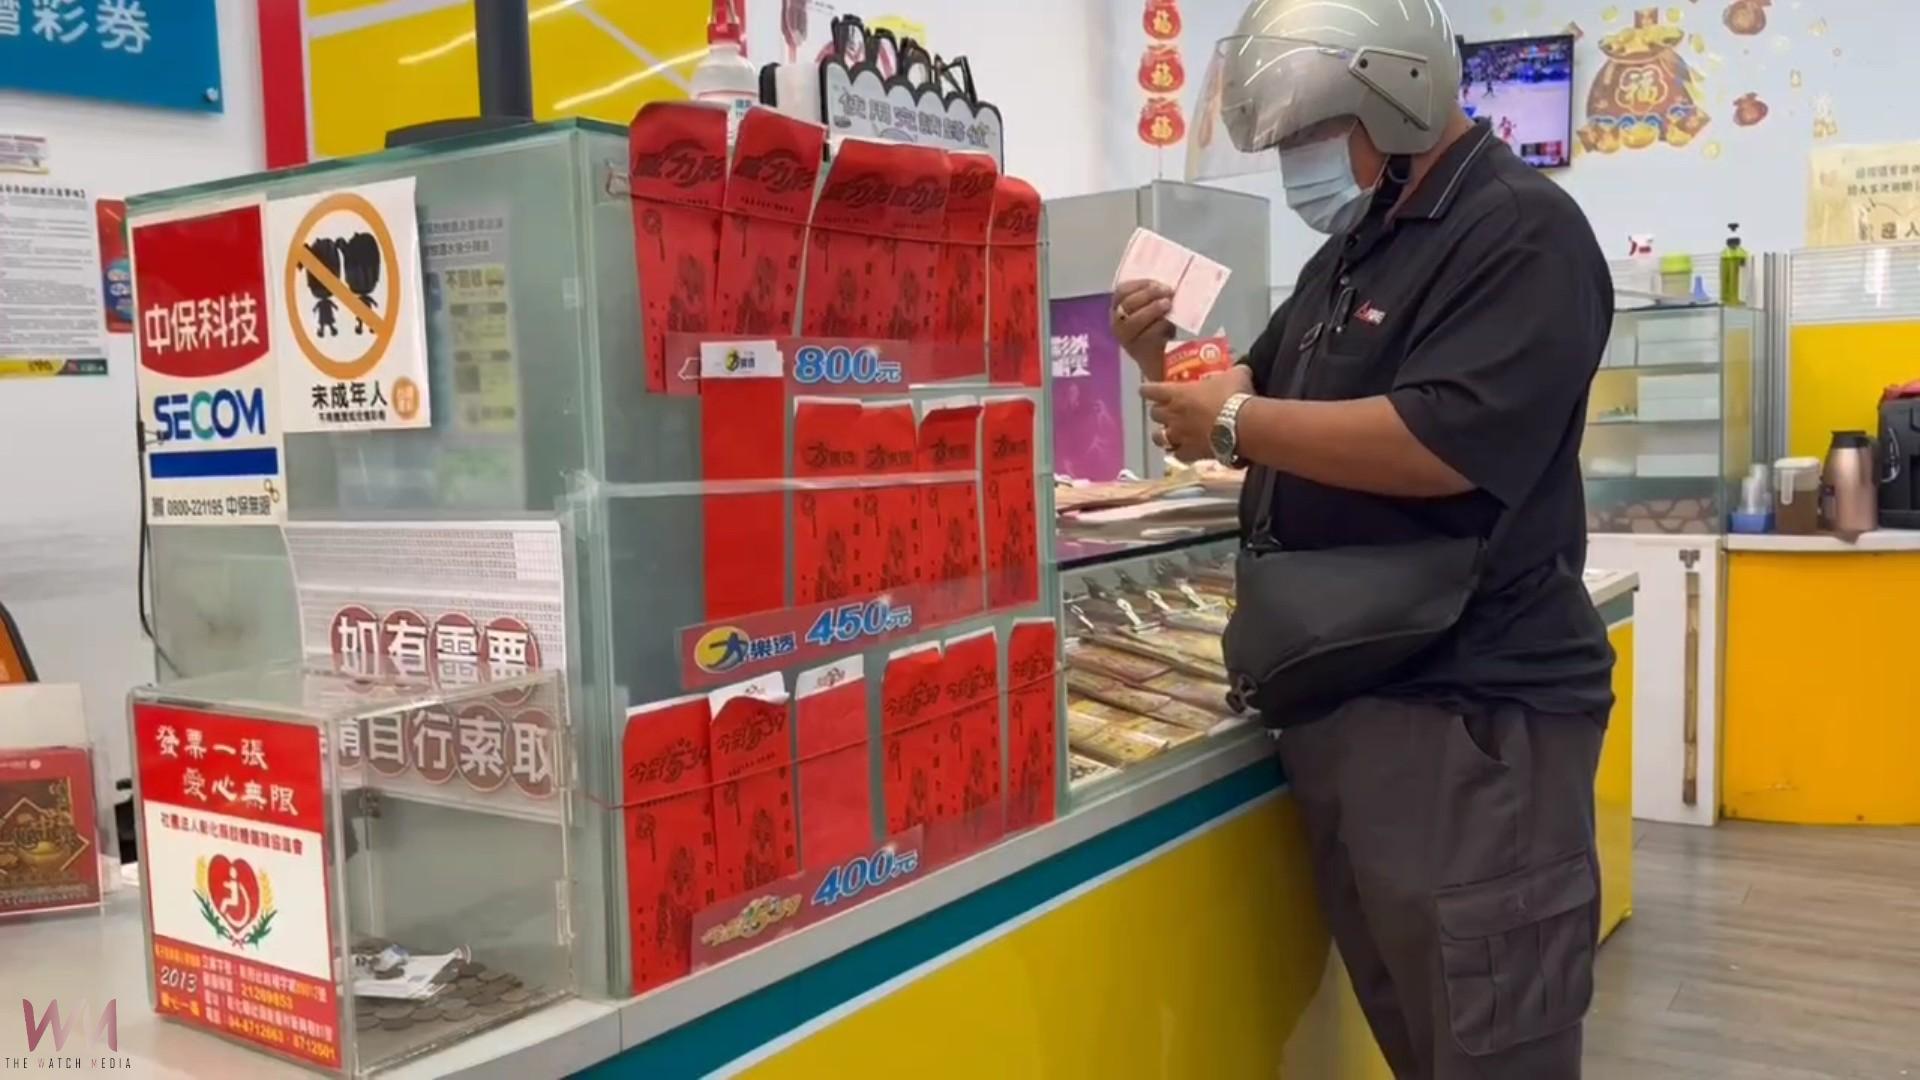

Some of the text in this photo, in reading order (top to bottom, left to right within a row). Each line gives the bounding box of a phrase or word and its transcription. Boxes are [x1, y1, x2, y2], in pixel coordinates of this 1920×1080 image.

[144, 294, 260, 356] 中保科技
[154, 387, 266, 441] SECOM
[312, 382, 388, 409] 未成年人
[805, 599, 913, 646] 450元
[336, 614, 532, 691] 如有需要
[156, 725, 269, 770] 發票一張
[183, 767, 299, 816] 愛心無限
[812, 846, 918, 906] 400元
[160, 965, 198, 993] 2013
